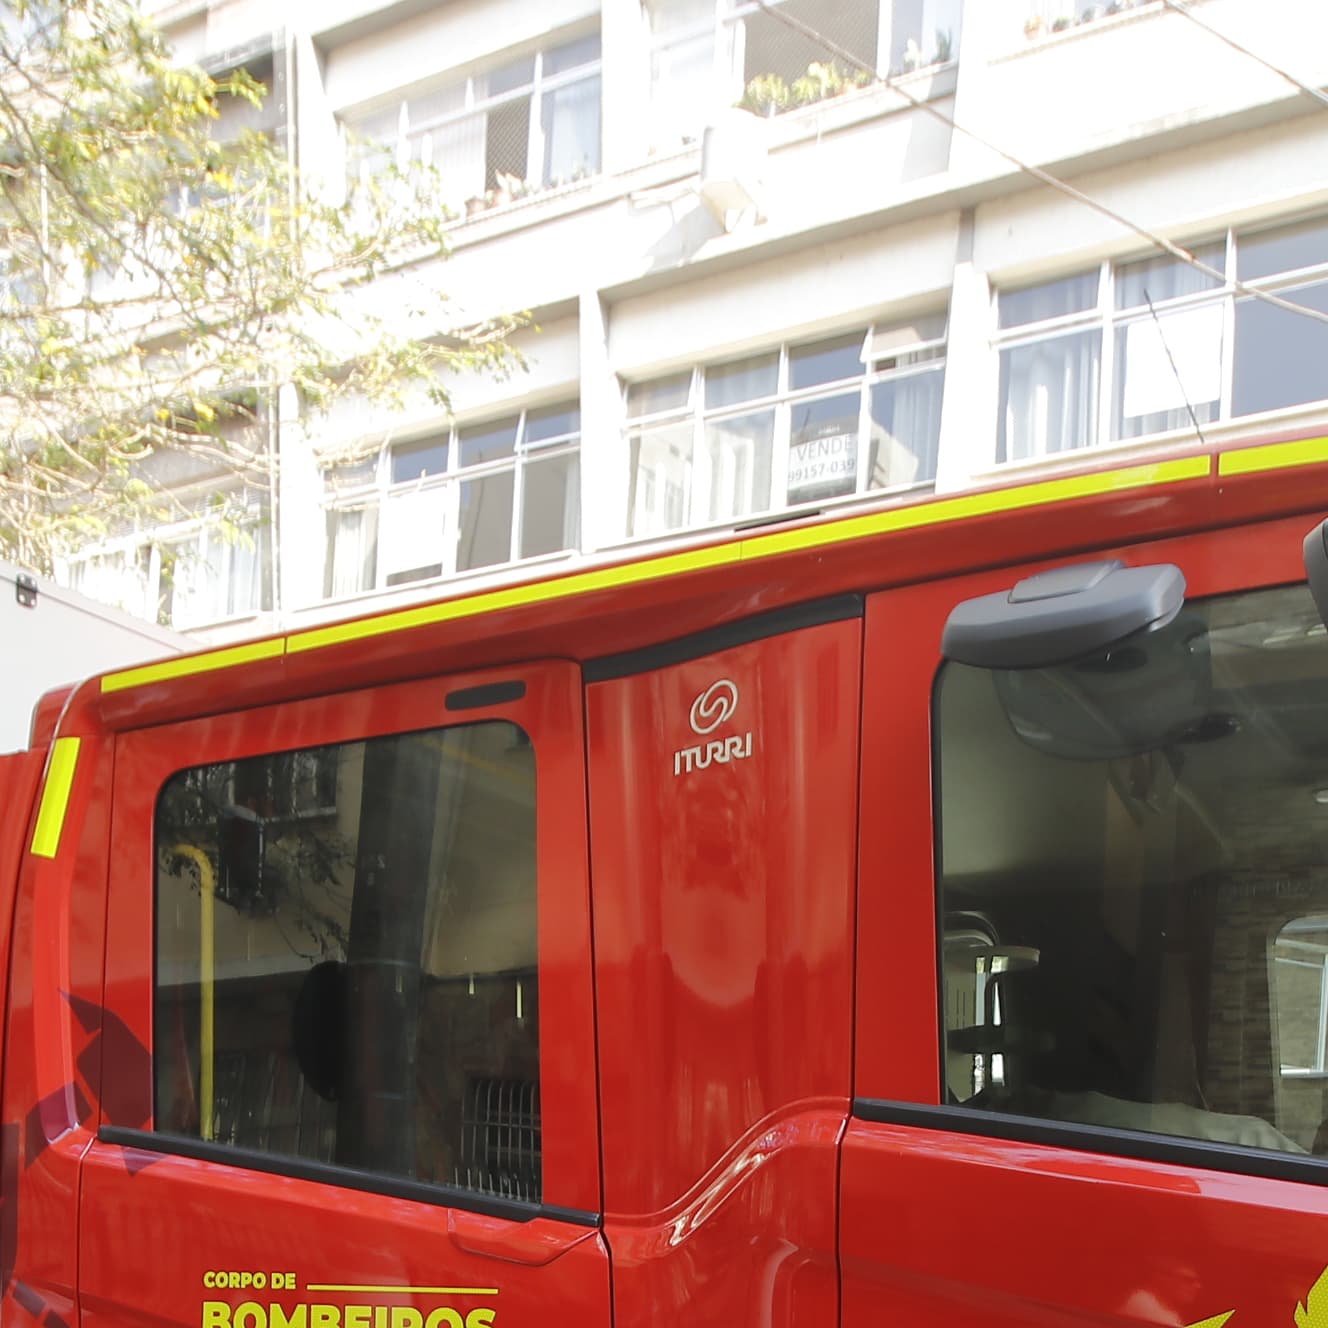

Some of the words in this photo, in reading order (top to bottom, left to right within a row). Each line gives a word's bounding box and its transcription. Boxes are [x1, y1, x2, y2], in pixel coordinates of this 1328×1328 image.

[674, 732, 752, 776] ITURRI
[203, 1272, 267, 1290] CORPO
[271, 1272, 297, 1290] DE
